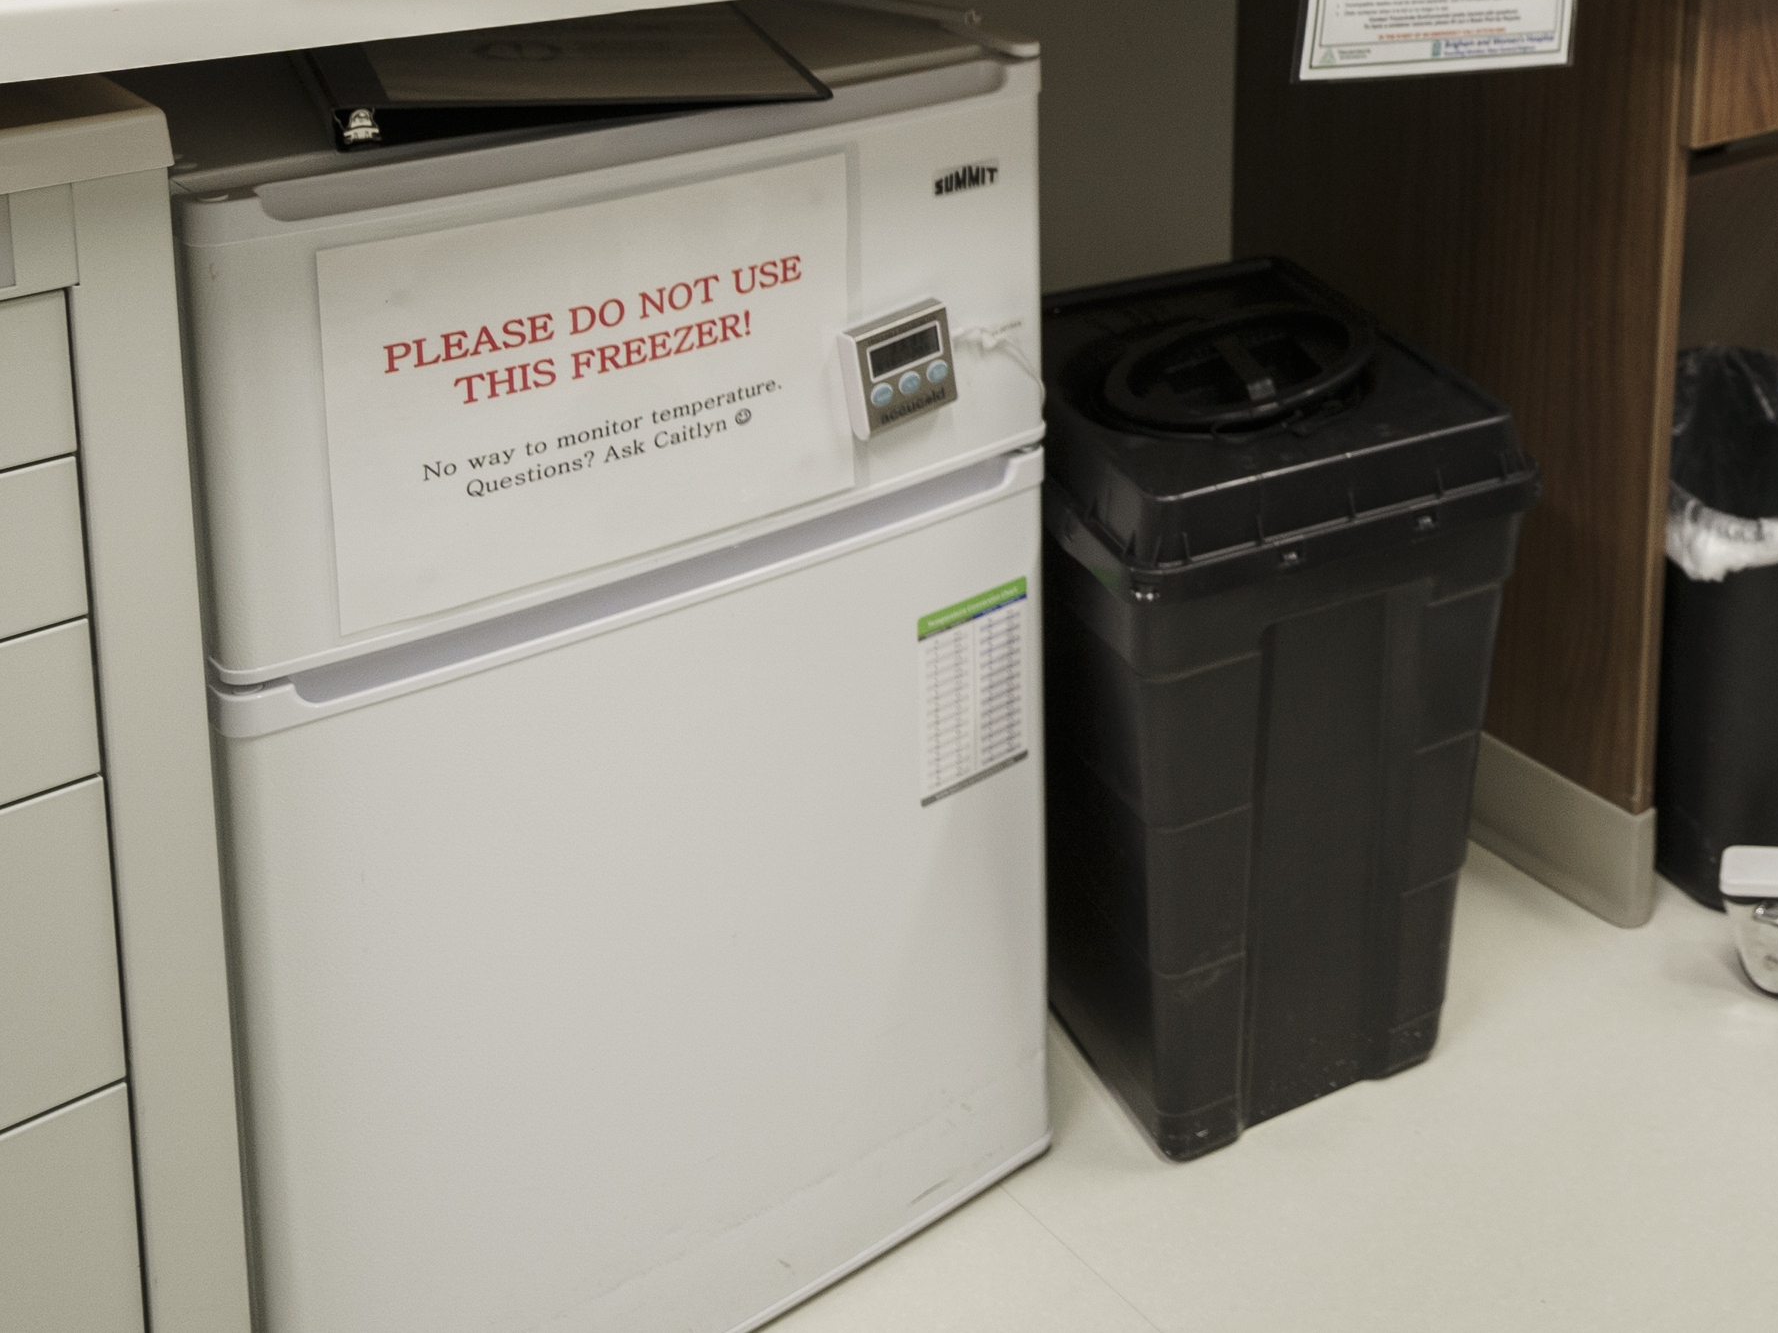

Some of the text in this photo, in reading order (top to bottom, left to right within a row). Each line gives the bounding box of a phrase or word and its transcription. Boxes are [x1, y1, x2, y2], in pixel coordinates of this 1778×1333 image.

[935, 165, 998, 196] SUMMIT
[383, 255, 802, 374] PLEASE DO NOT USE
[454, 310, 751, 404] THIS FREEZER!
[423, 378, 782, 481] No way to monitor temperature.
[466, 418, 727, 497] Questions? Ask Caitlyn
